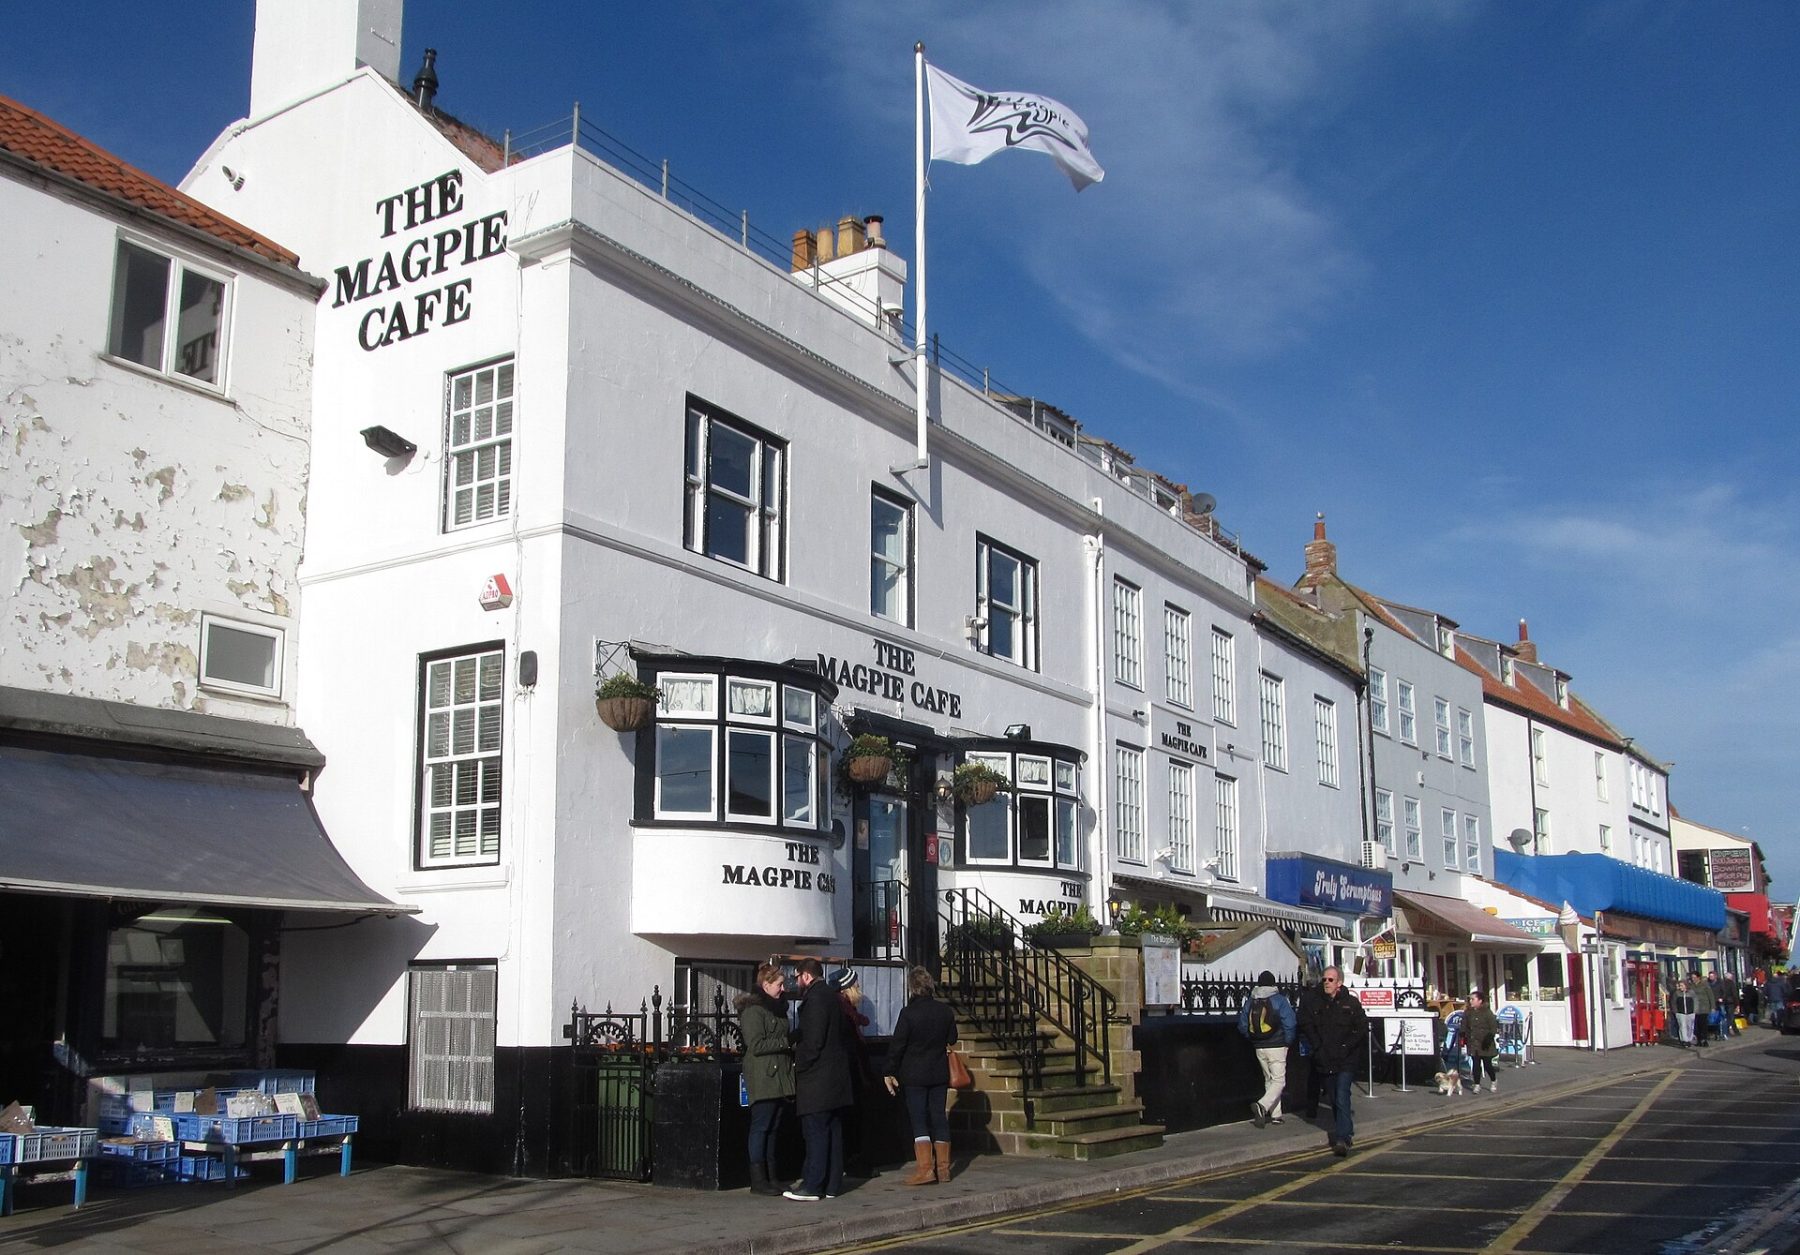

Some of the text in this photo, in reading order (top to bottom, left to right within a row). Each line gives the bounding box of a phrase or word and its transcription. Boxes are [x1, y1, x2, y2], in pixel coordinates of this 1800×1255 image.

[376, 168, 463, 238] THE
[332, 210, 508, 308] MAGPIE
[358, 278, 472, 351] CAFE
[873, 638, 916, 676] THE
[817, 653, 962, 718] MAGPIE CAFE
[1177, 721, 1191, 737] THE
[1161, 732, 1207, 759] MAGPIE CAFE
[785, 842, 819, 865] THE
[1713, 865, 1750, 873] Bowling
[722, 865, 812, 890] MAGPIE
[1061, 881, 1082, 898] THE
[1314, 870, 1382, 906] Truly Scrumptious
